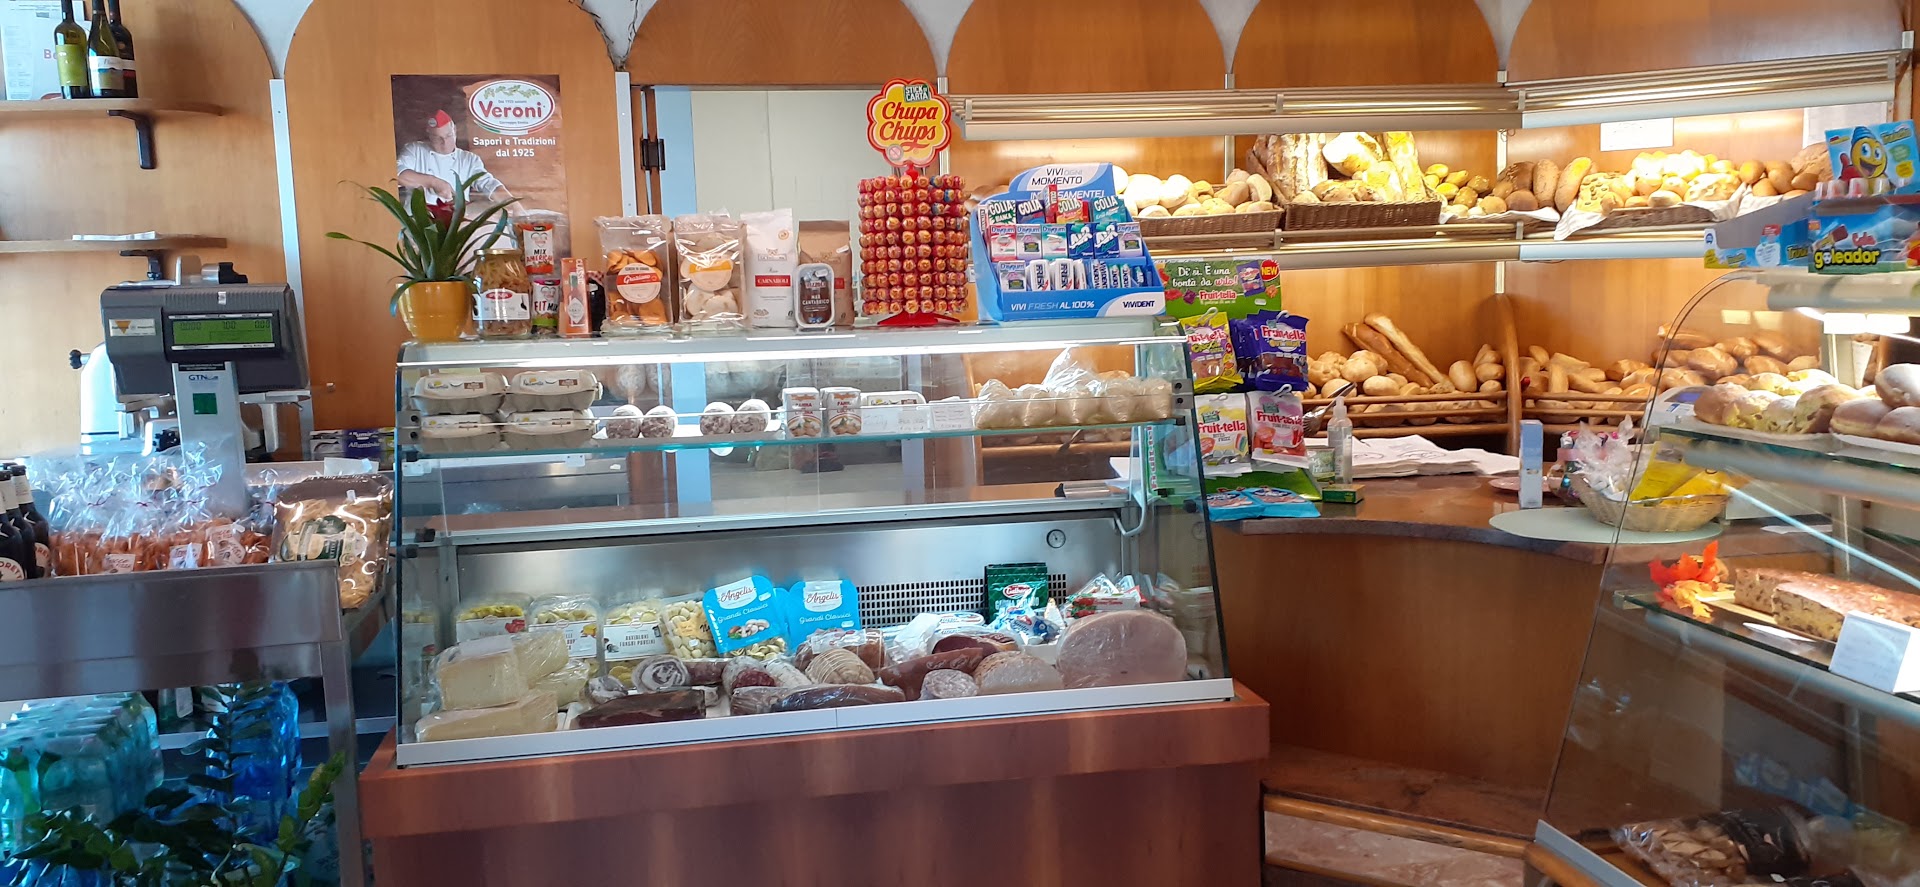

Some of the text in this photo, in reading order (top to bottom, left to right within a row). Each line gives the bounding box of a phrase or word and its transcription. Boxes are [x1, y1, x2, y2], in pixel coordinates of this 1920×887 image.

[905, 85, 923, 94] STICK
[906, 92, 929, 102] CARTA
[478, 101, 542, 118] Veroni
[881, 101, 939, 125] Chupa
[879, 121, 938, 147] Chups
[473, 137, 503, 147] Sapori
[512, 136, 556, 146] Tradizioni
[496, 148, 535, 158] dal 1925
[1046, 167, 1064, 176] VIVI
[1031, 176, 1083, 186] MOMENTO
[1030, 189, 1105, 200] INSAMENTE!
[1815, 247, 1880, 268] goleador
[1262, 266, 1278, 276] NEW
[1172, 278, 1197, 287] bontà
[1200, 277, 1213, 286] da
[534, 300, 547, 311] FIT
[1010, 300, 1095, 311] VIVI FRESH AL 100%
[1123, 300, 1155, 309] VIVIDENT
[1198, 420, 1246, 434] Fruit-tella
[720, 586, 753, 602] Angelis
[806, 591, 840, 604] Angelis
[717, 611, 742, 623] Grandi
[799, 615, 825, 625] Grandi
